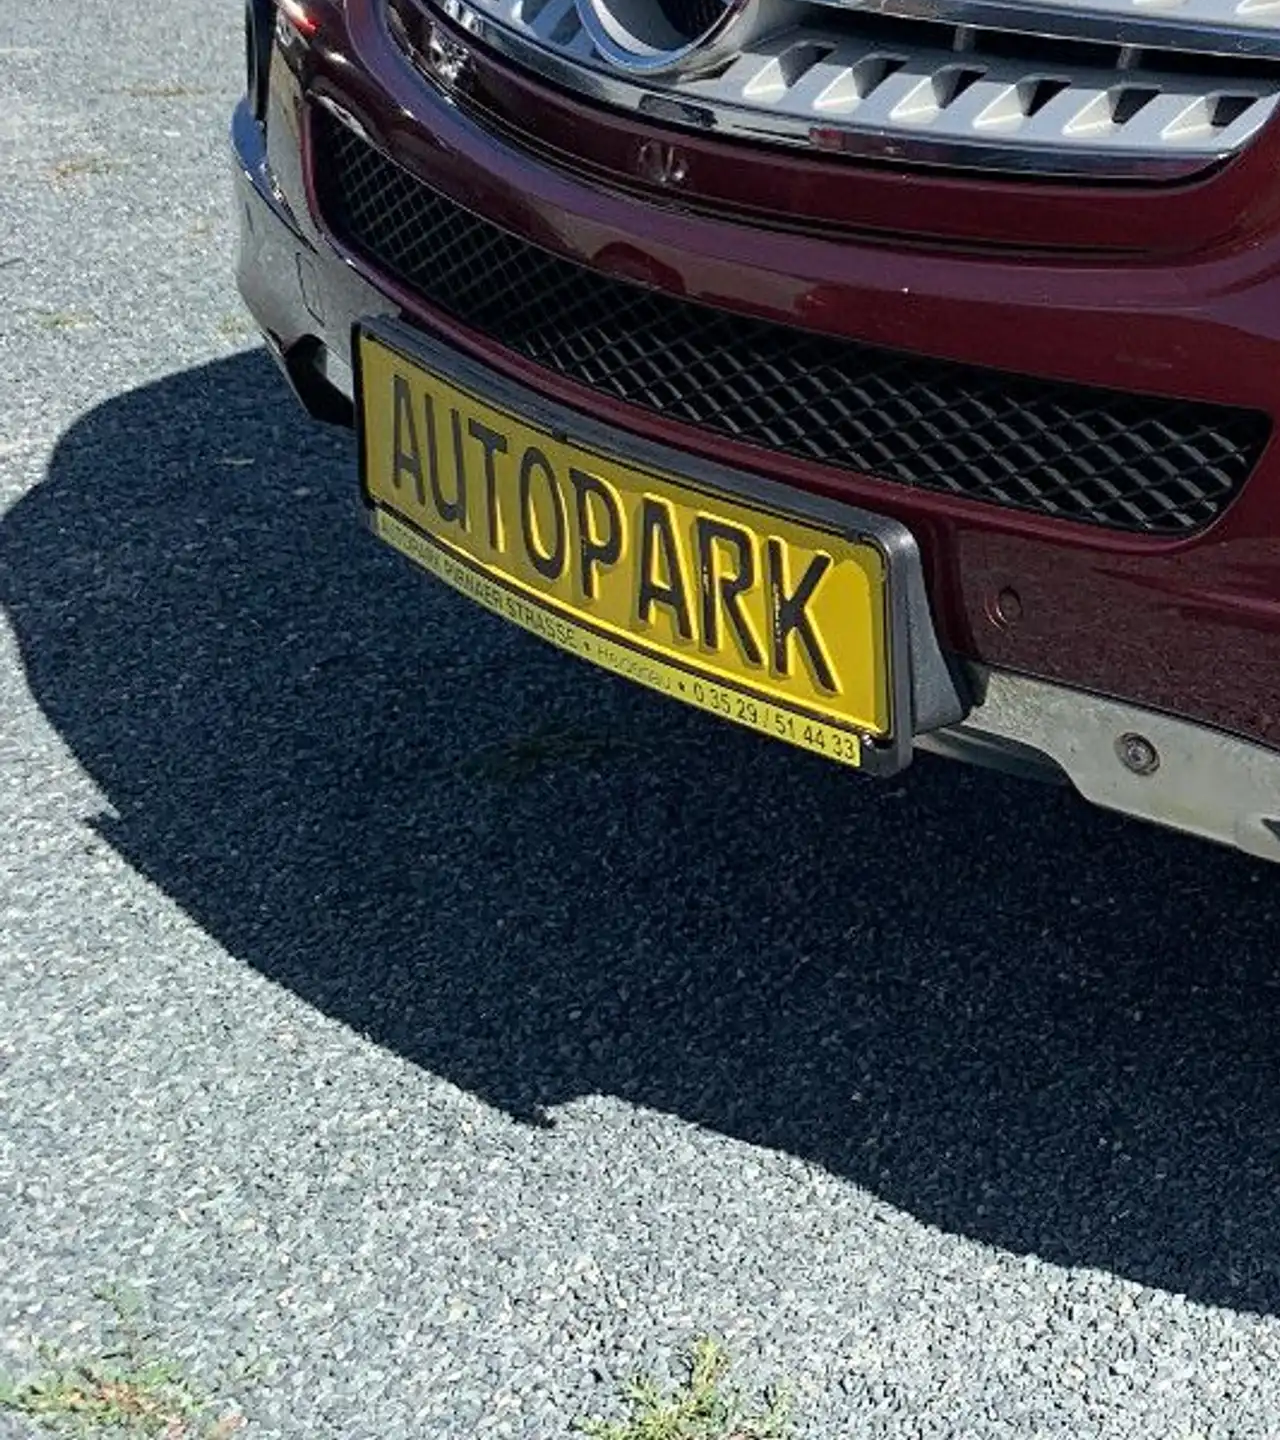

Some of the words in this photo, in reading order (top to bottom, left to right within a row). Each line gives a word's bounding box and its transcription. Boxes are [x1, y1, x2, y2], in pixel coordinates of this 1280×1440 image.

[391, 373, 840, 697] AUTOPARK
[507, 603, 578, 649] STRASSE
[692, 683, 705, 703] 0
[710, 688, 731, 714] 35
[736, 699, 759, 723] 29
[775, 713, 796, 740] 51
[803, 726, 826, 750] 44
[832, 734, 856, 760] 33
